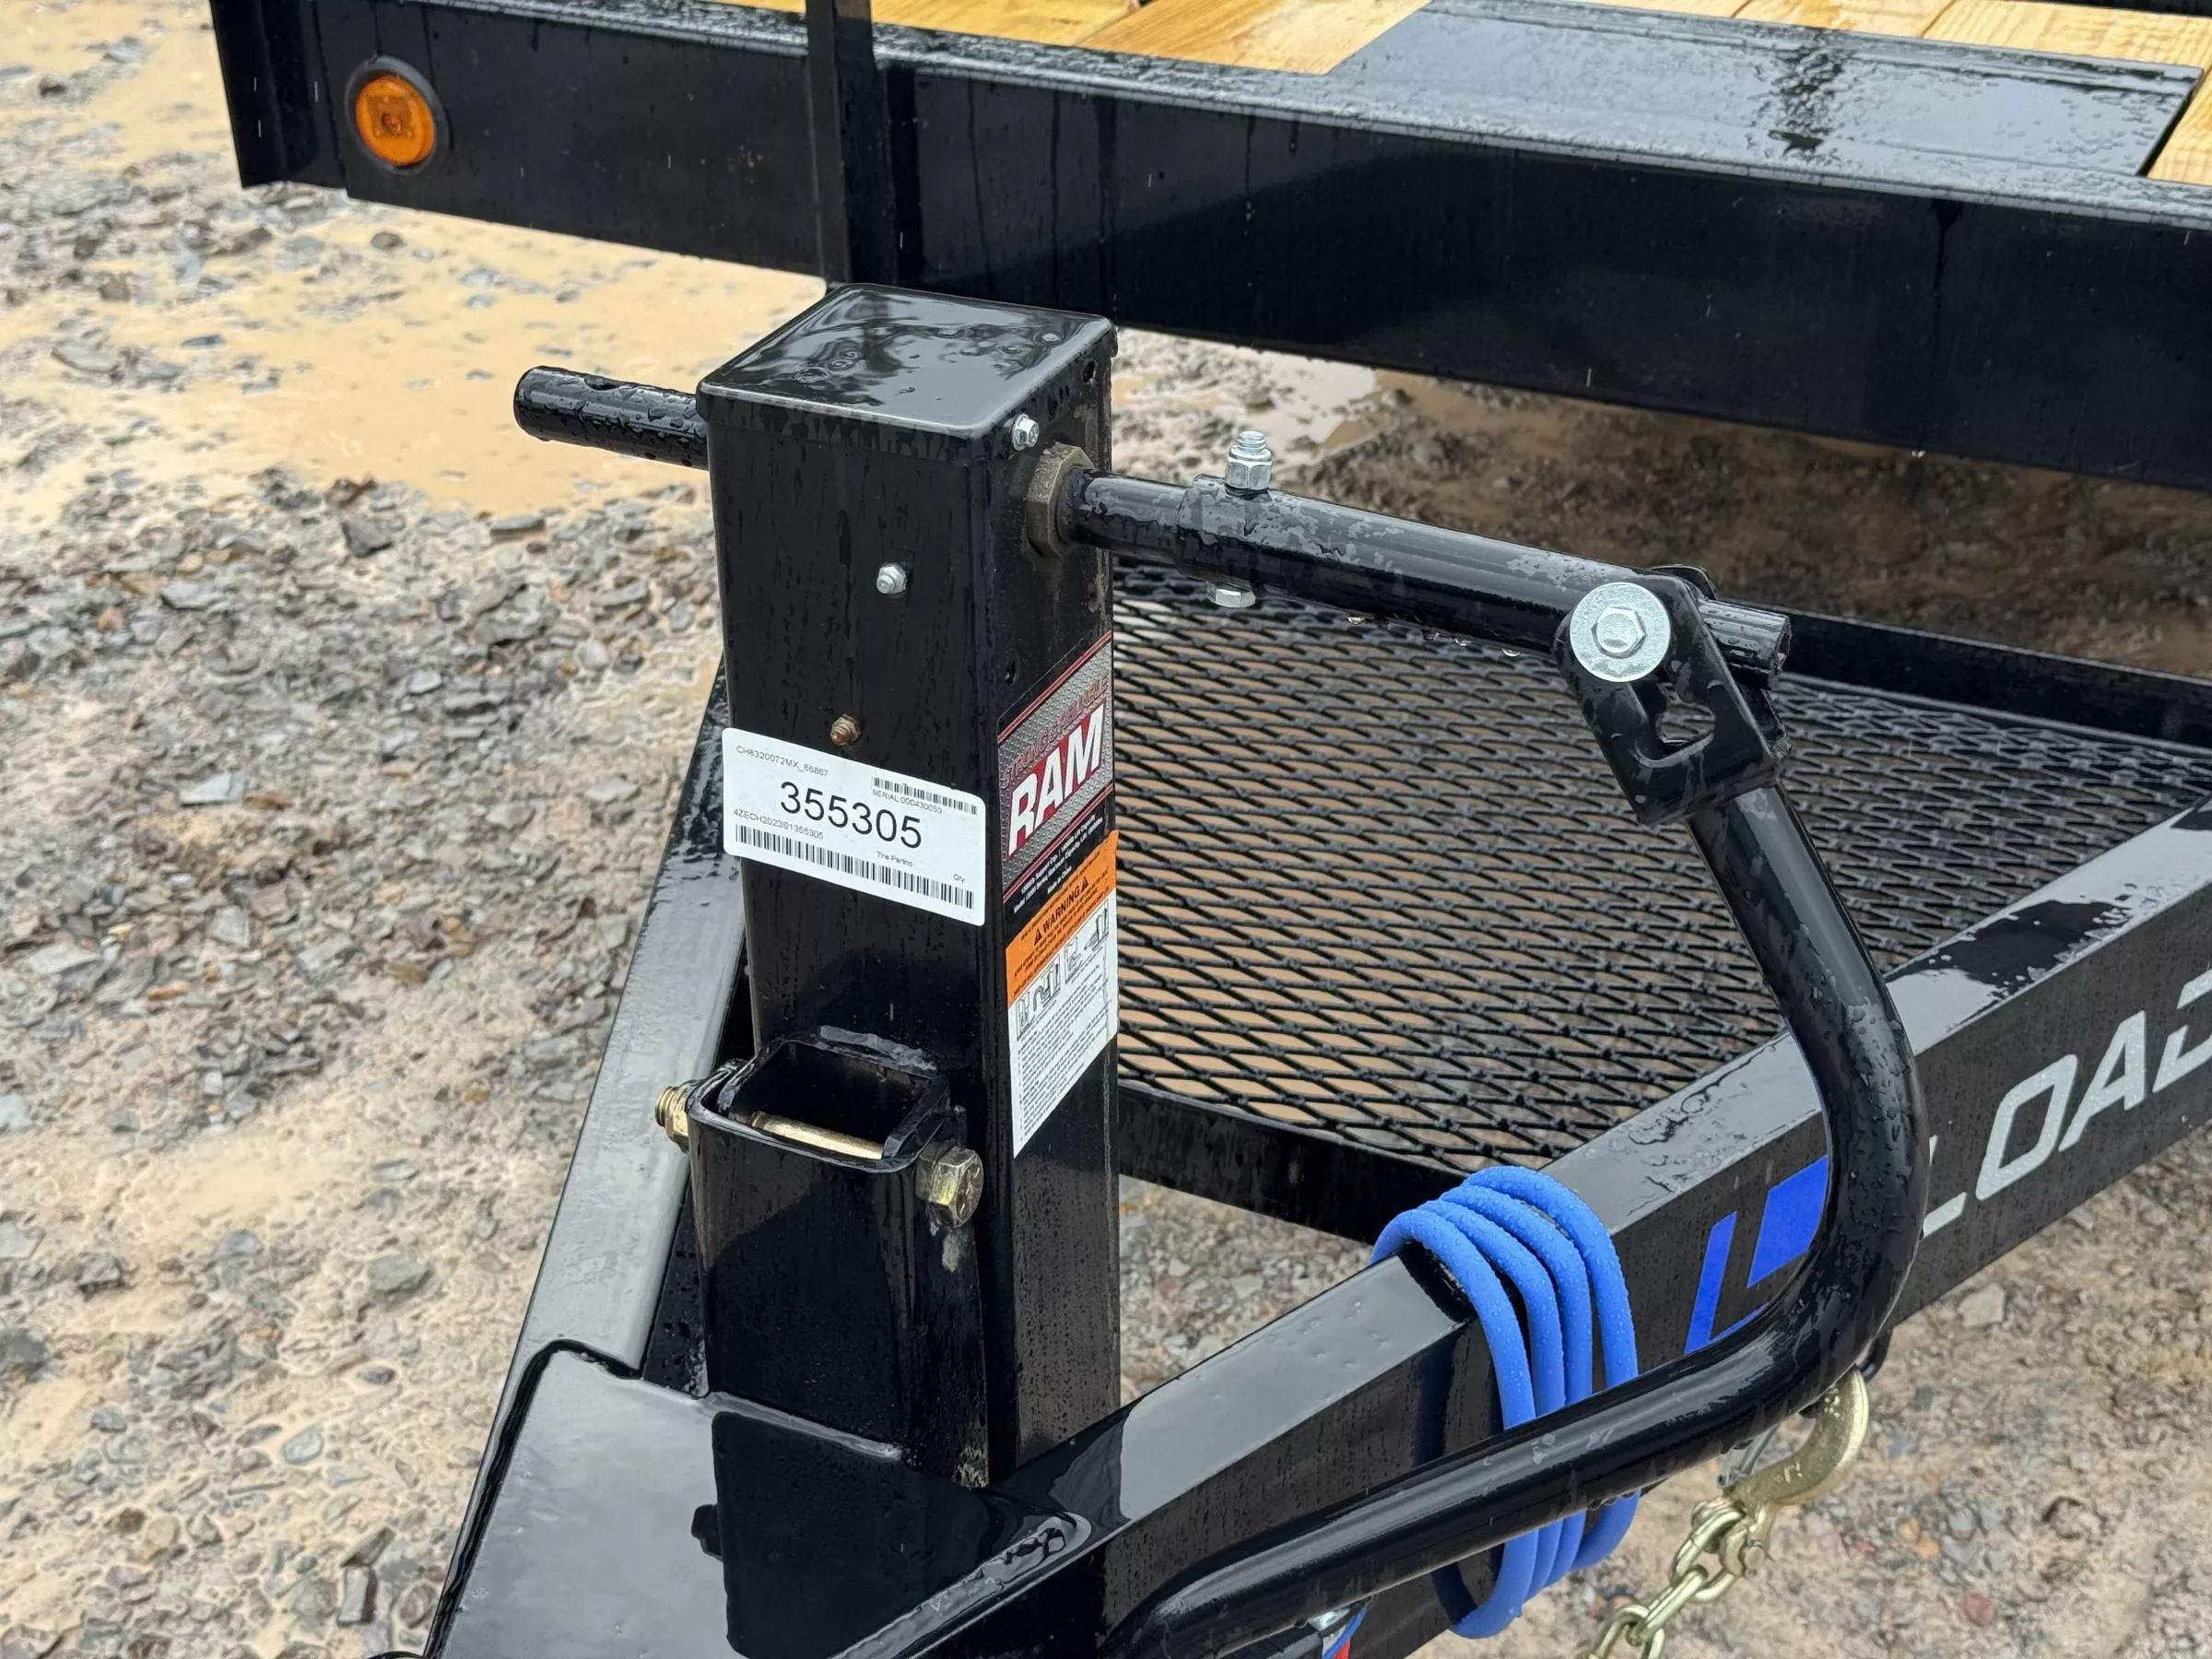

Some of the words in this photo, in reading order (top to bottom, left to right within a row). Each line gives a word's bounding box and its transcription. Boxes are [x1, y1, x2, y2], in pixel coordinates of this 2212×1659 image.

[1007, 702, 1104, 858] RAM
[780, 781, 923, 850] 355305
[1042, 885, 1080, 935] WARNING
